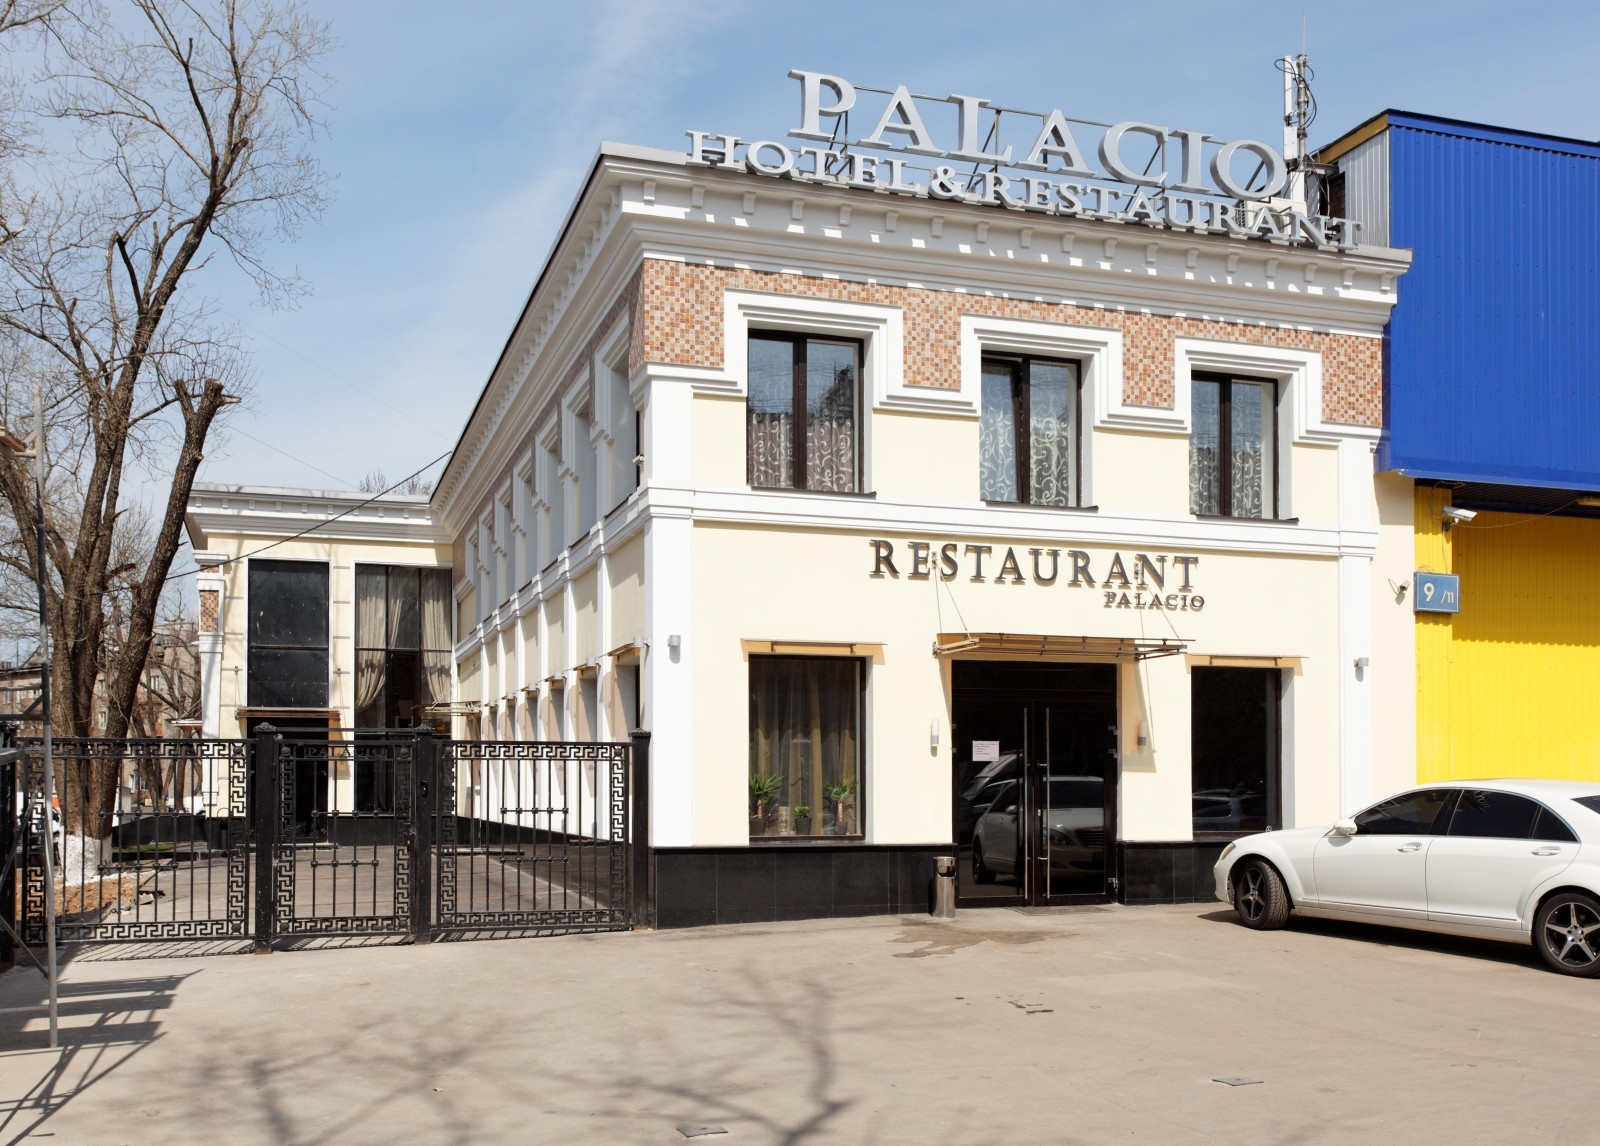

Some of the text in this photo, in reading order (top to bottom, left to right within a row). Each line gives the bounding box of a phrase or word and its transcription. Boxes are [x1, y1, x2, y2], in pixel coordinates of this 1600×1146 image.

[788, 69, 1287, 201] PALACIO
[869, 539, 1198, 588] RESTAURANT
[1105, 591, 1205, 608] PALACIO
